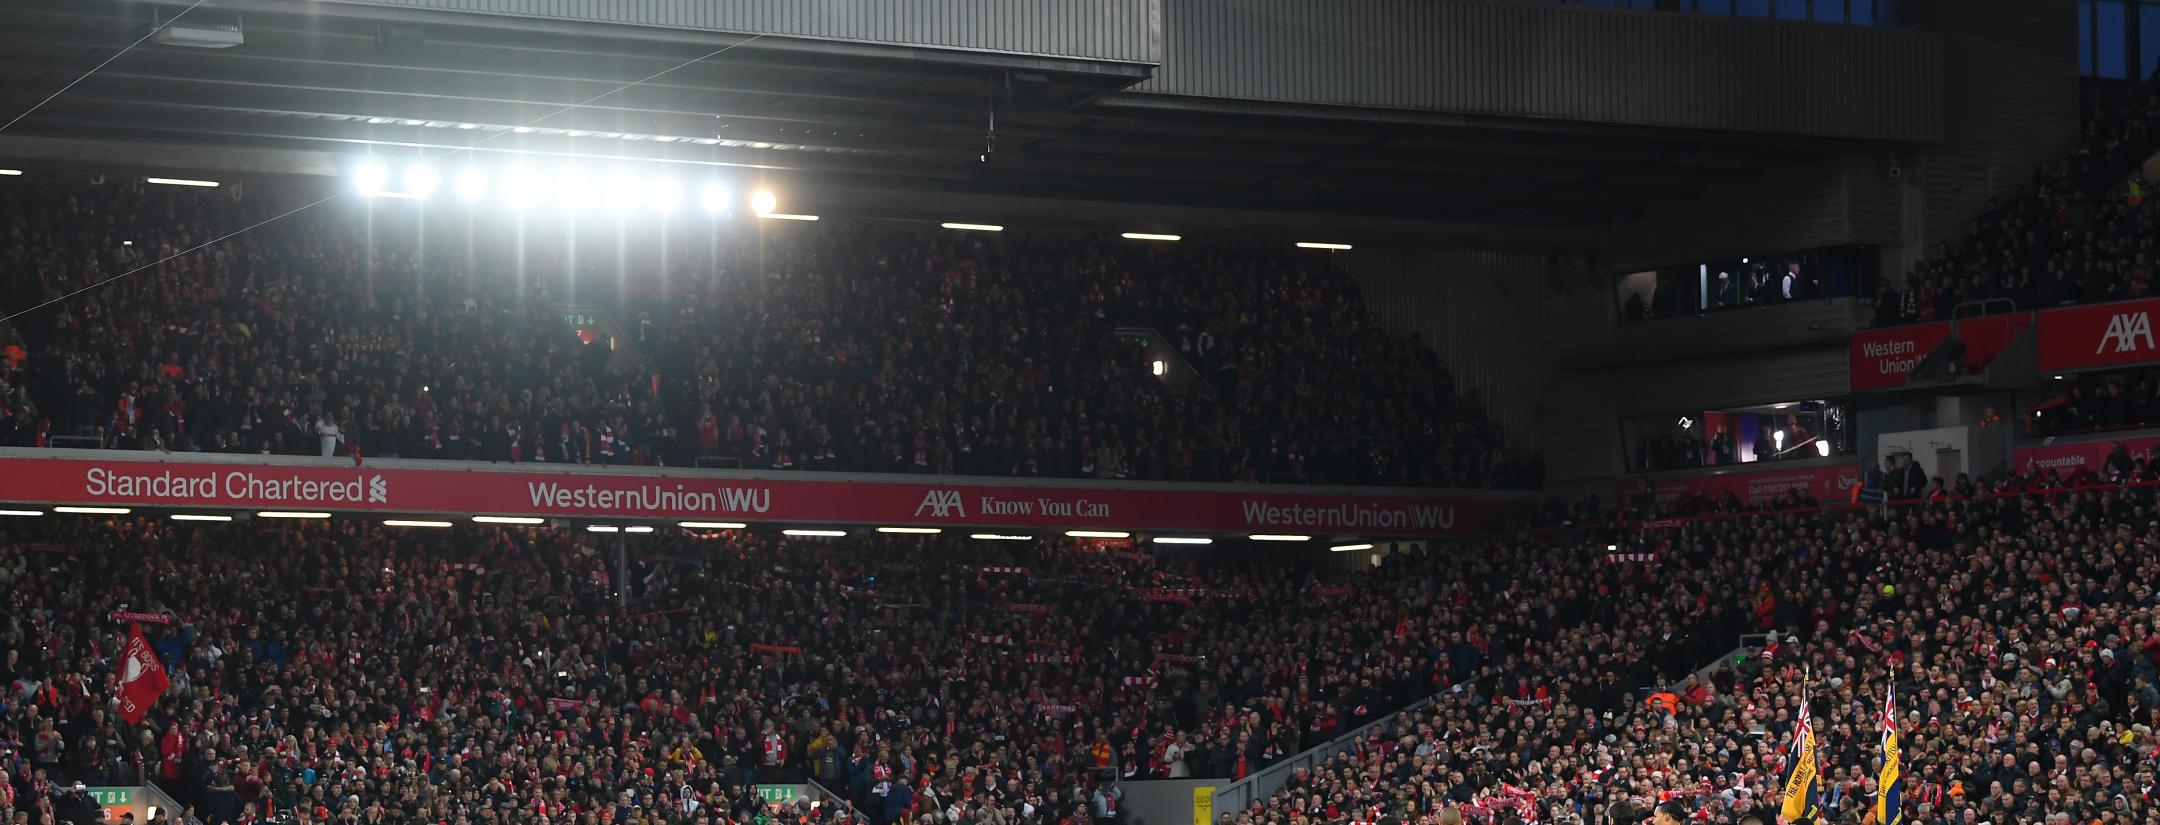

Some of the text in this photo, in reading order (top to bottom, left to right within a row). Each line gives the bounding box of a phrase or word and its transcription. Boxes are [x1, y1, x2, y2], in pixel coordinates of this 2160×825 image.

[2096, 312, 2155, 354] AXA
[1863, 340, 1914, 357] Western
[1880, 357, 1914, 375] Union
[86, 468, 362, 501] Standard Chartered
[528, 482, 716, 512] WesternUnion
[914, 490, 966, 517] AXA
[981, 496, 1109, 517] Know You Can
[1243, 500, 1407, 527] WesternUnion
[140, 651, 159, 672] BOSS
[1786, 785, 1798, 798] THE
